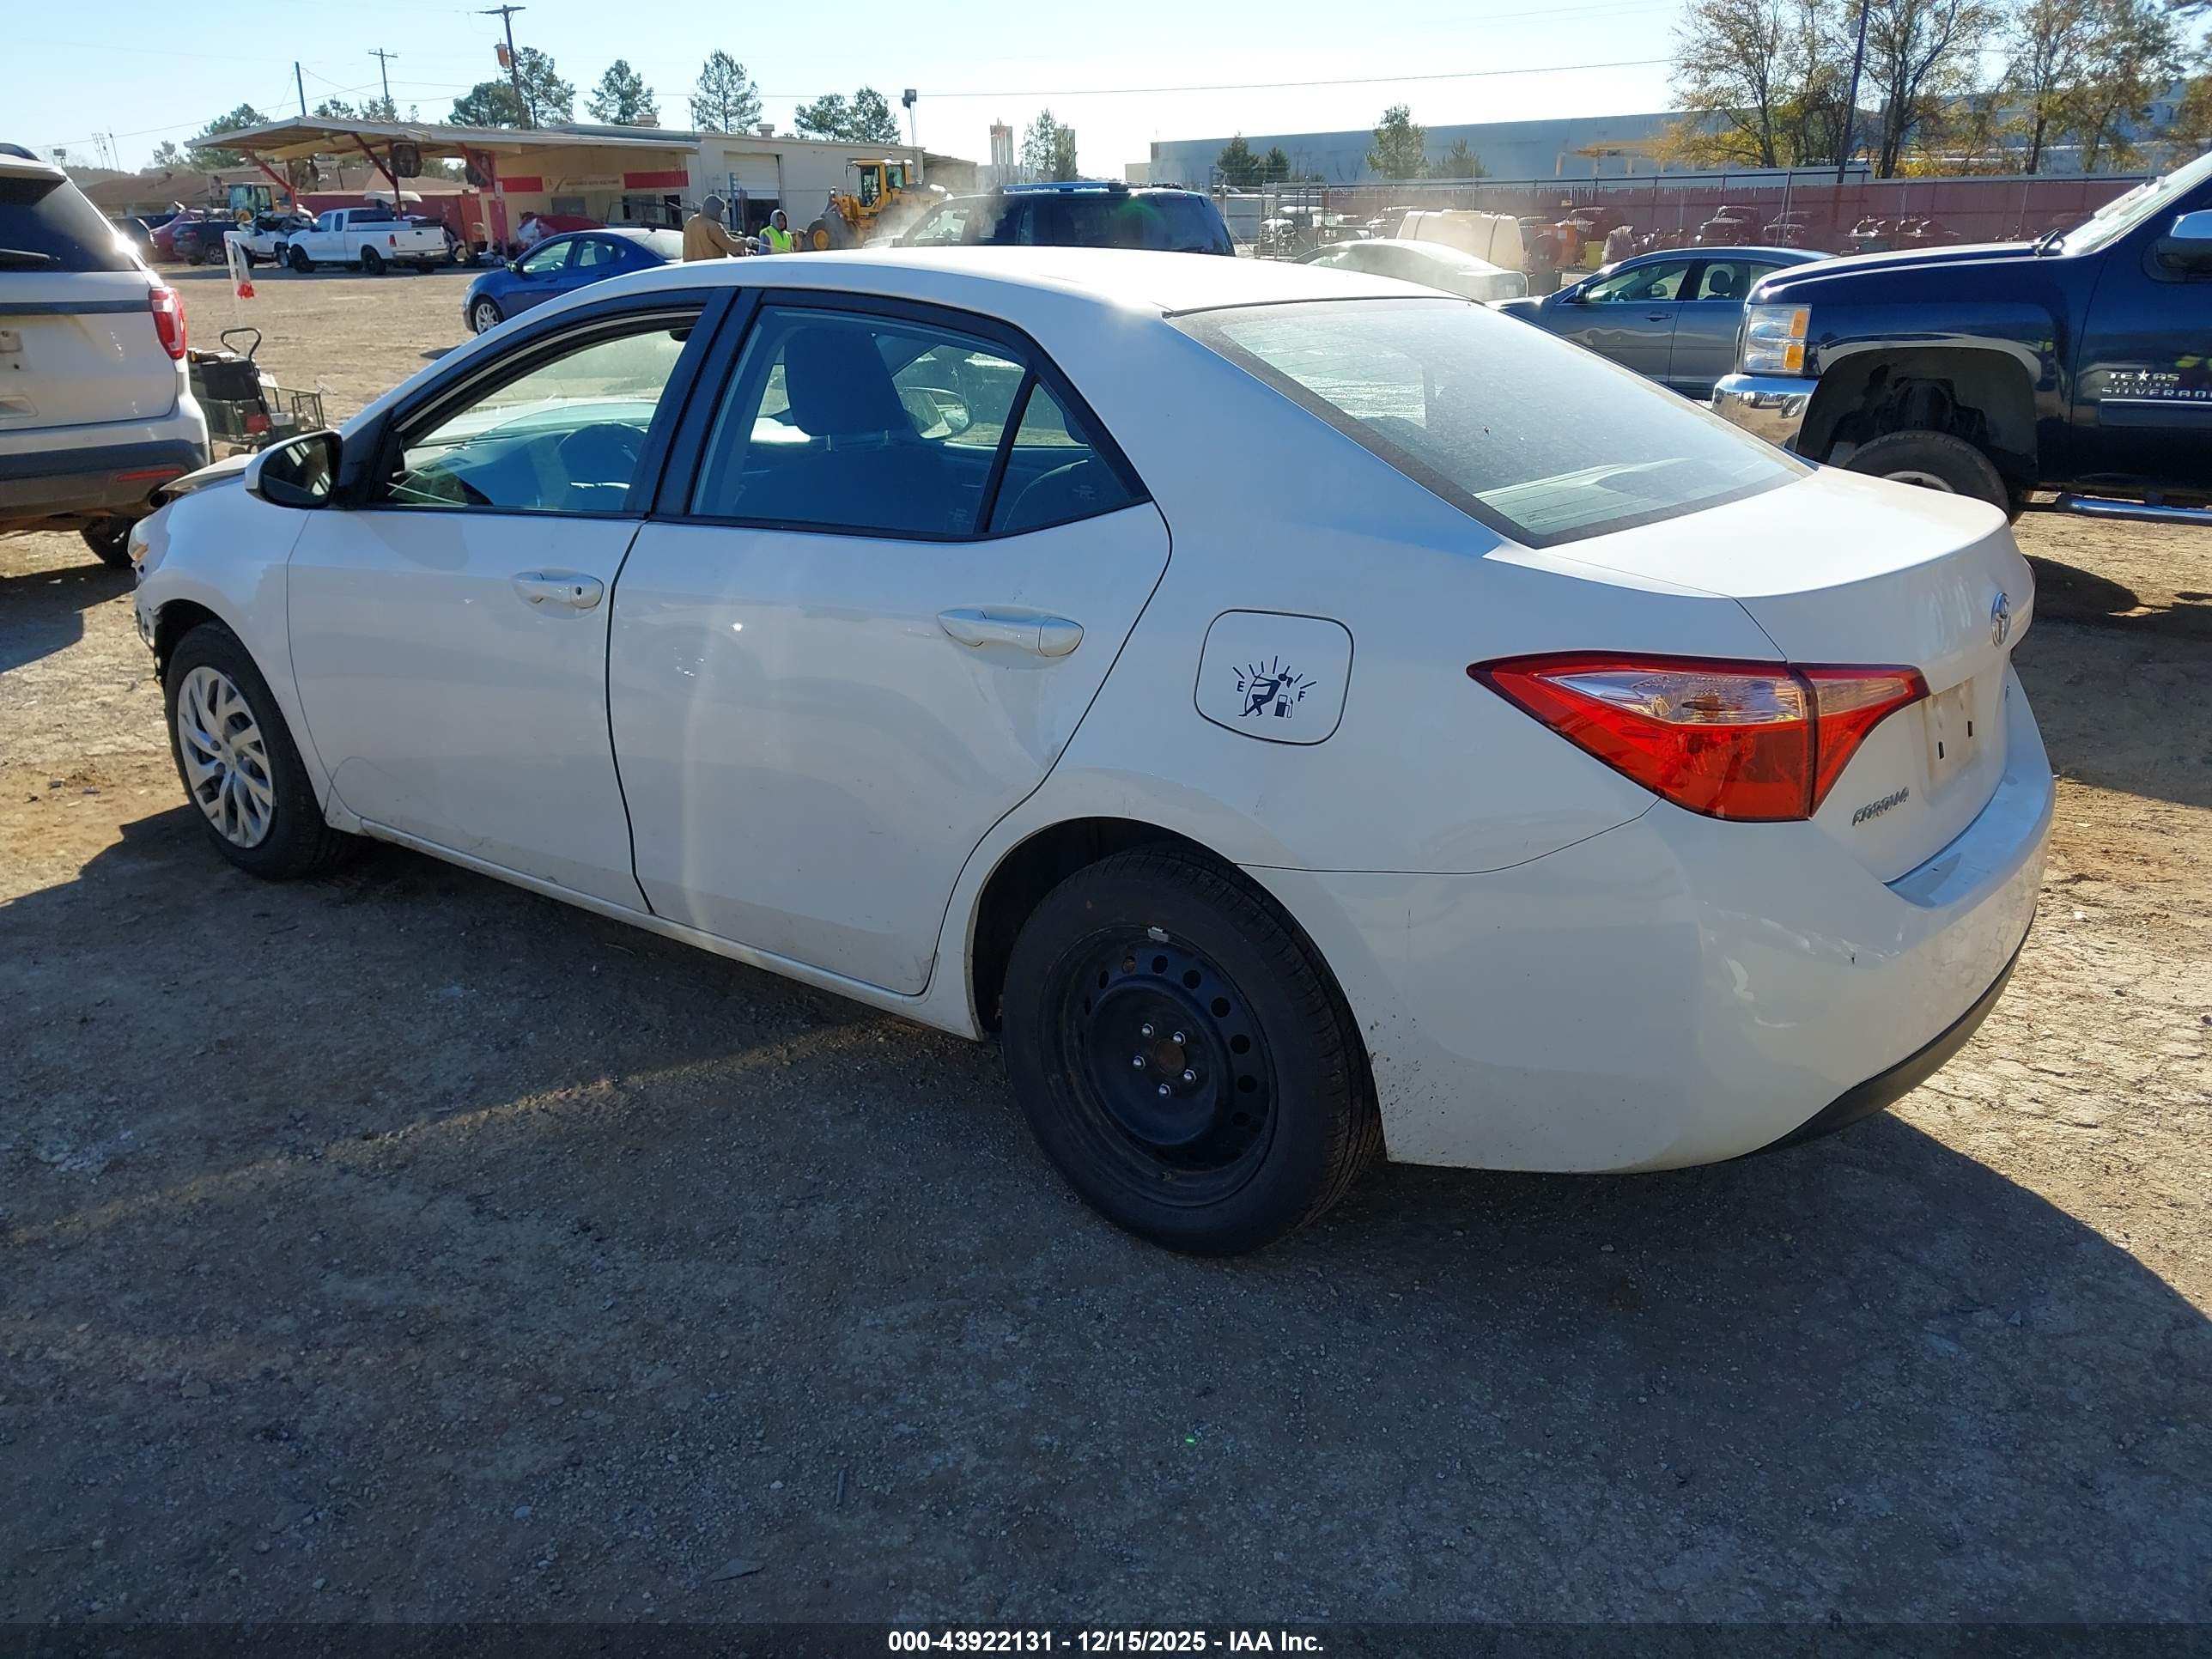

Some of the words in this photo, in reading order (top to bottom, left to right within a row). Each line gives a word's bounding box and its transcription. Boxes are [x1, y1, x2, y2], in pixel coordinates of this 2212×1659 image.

[2100, 386, 2212, 398] SILVERAD
[1237, 680, 1246, 693] E
[1297, 690, 1307, 702] F
